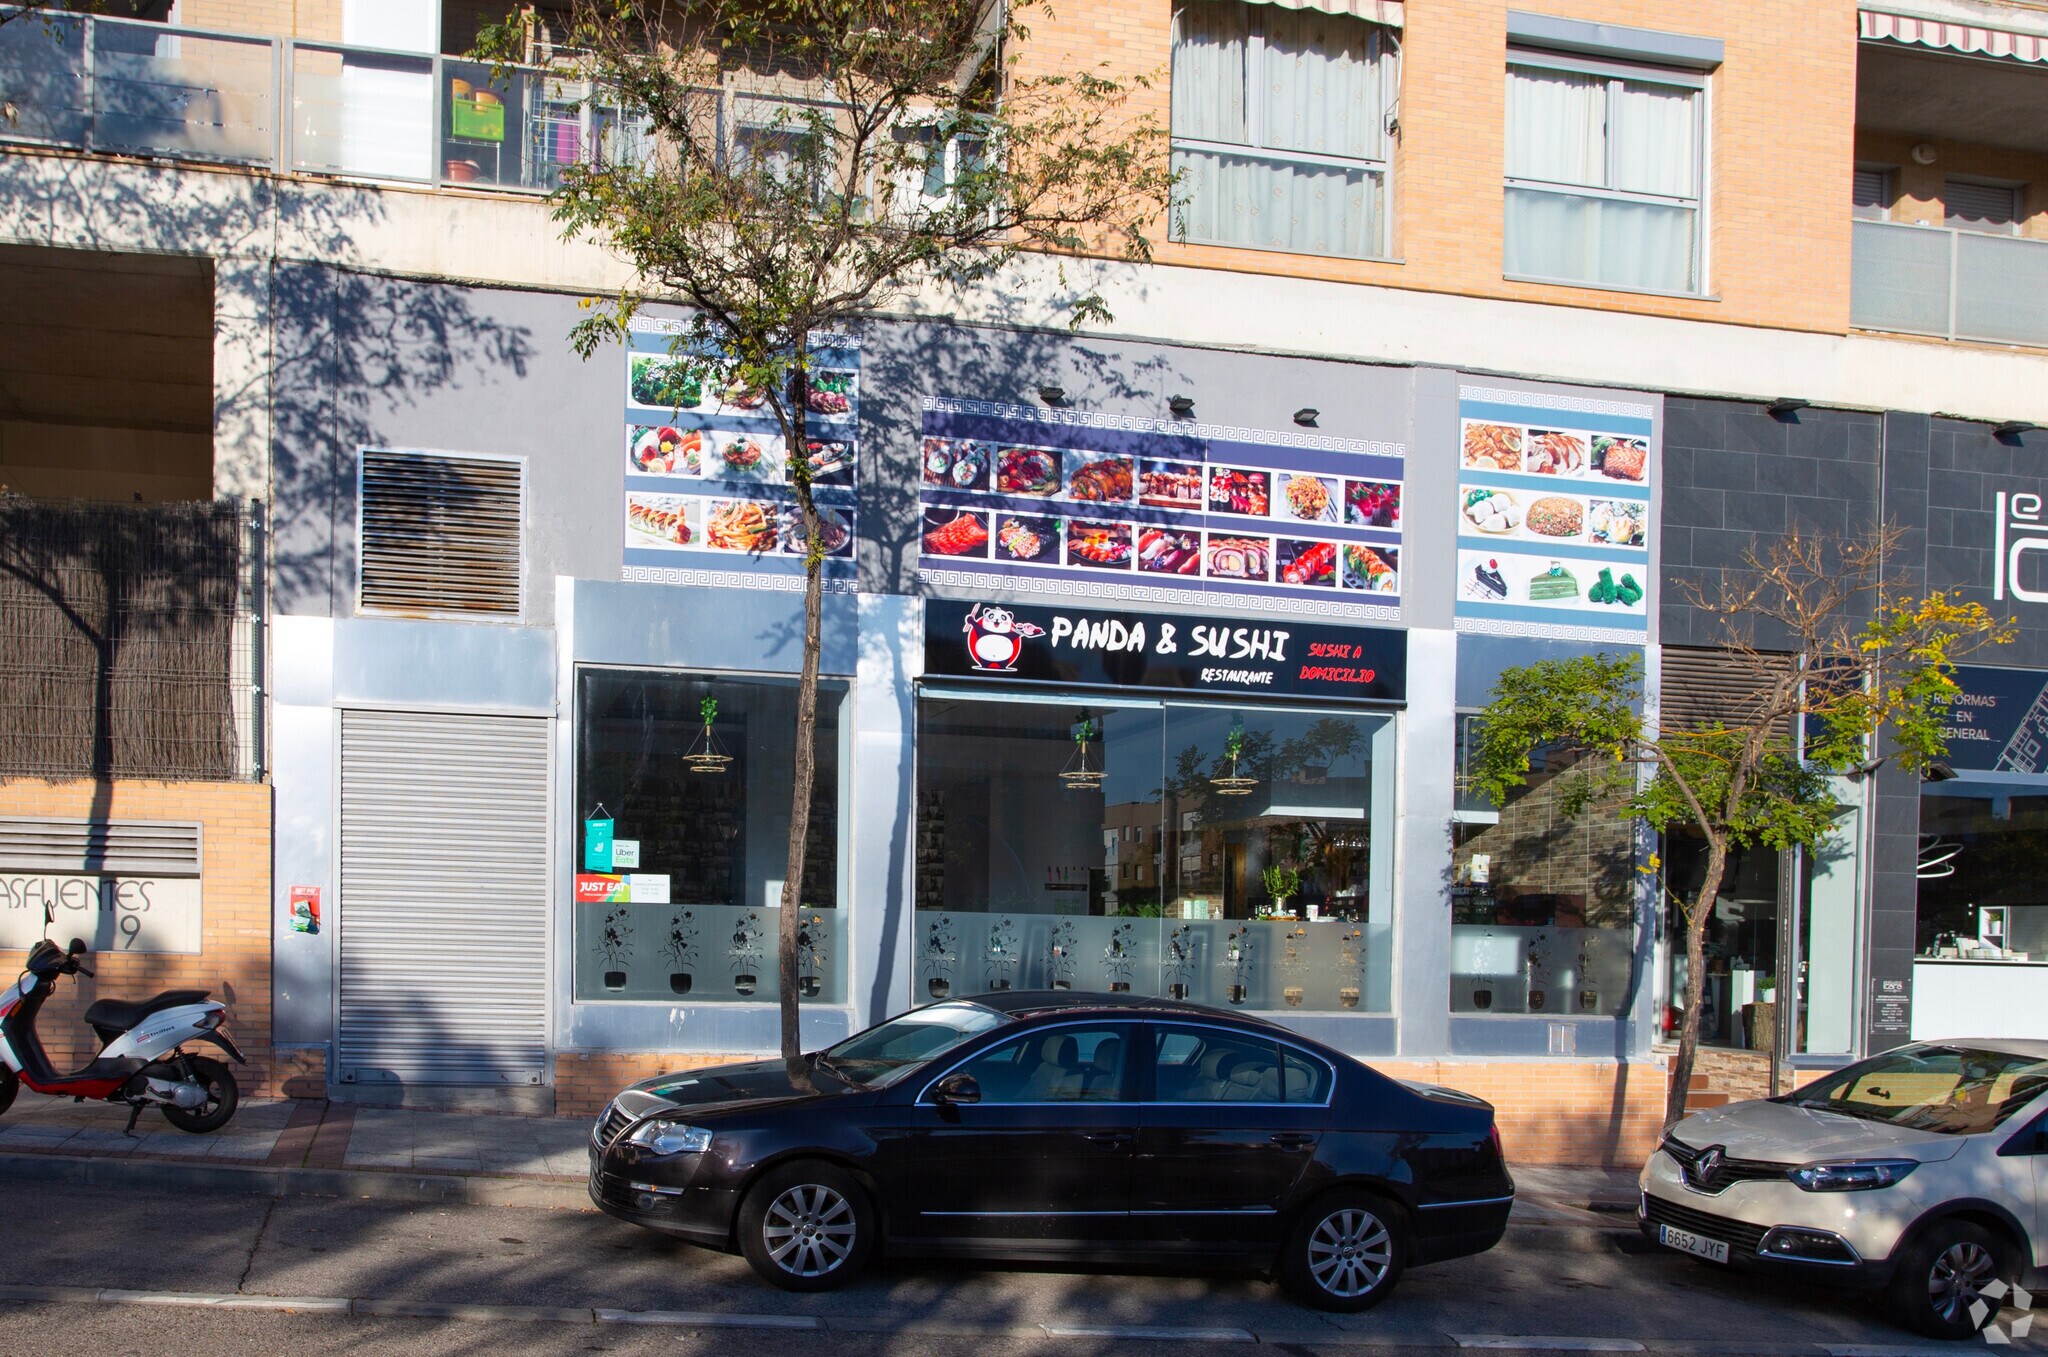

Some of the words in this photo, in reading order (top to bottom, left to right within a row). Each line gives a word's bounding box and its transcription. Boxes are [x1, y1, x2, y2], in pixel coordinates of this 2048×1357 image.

[1051, 616, 1146, 652] PANDA
[1155, 622, 1177, 654] &
[1188, 625, 1290, 661] SUSHI
[1307, 643, 1349, 658] SUSHI
[1352, 645, 1362, 658] A
[1201, 668, 1274, 685] RESTAURANTE
[1299, 666, 1376, 683] DOMICILIO
[1956, 711, 1973, 722] EN
[615, 848, 634, 857] Uber
[580, 882, 605, 892] JUST
[606, 882, 625, 892] EAT
[120, 914, 141, 950] 9
[1667, 1229, 1696, 1251] 6652
[1700, 1240, 1725, 1259] JYF
